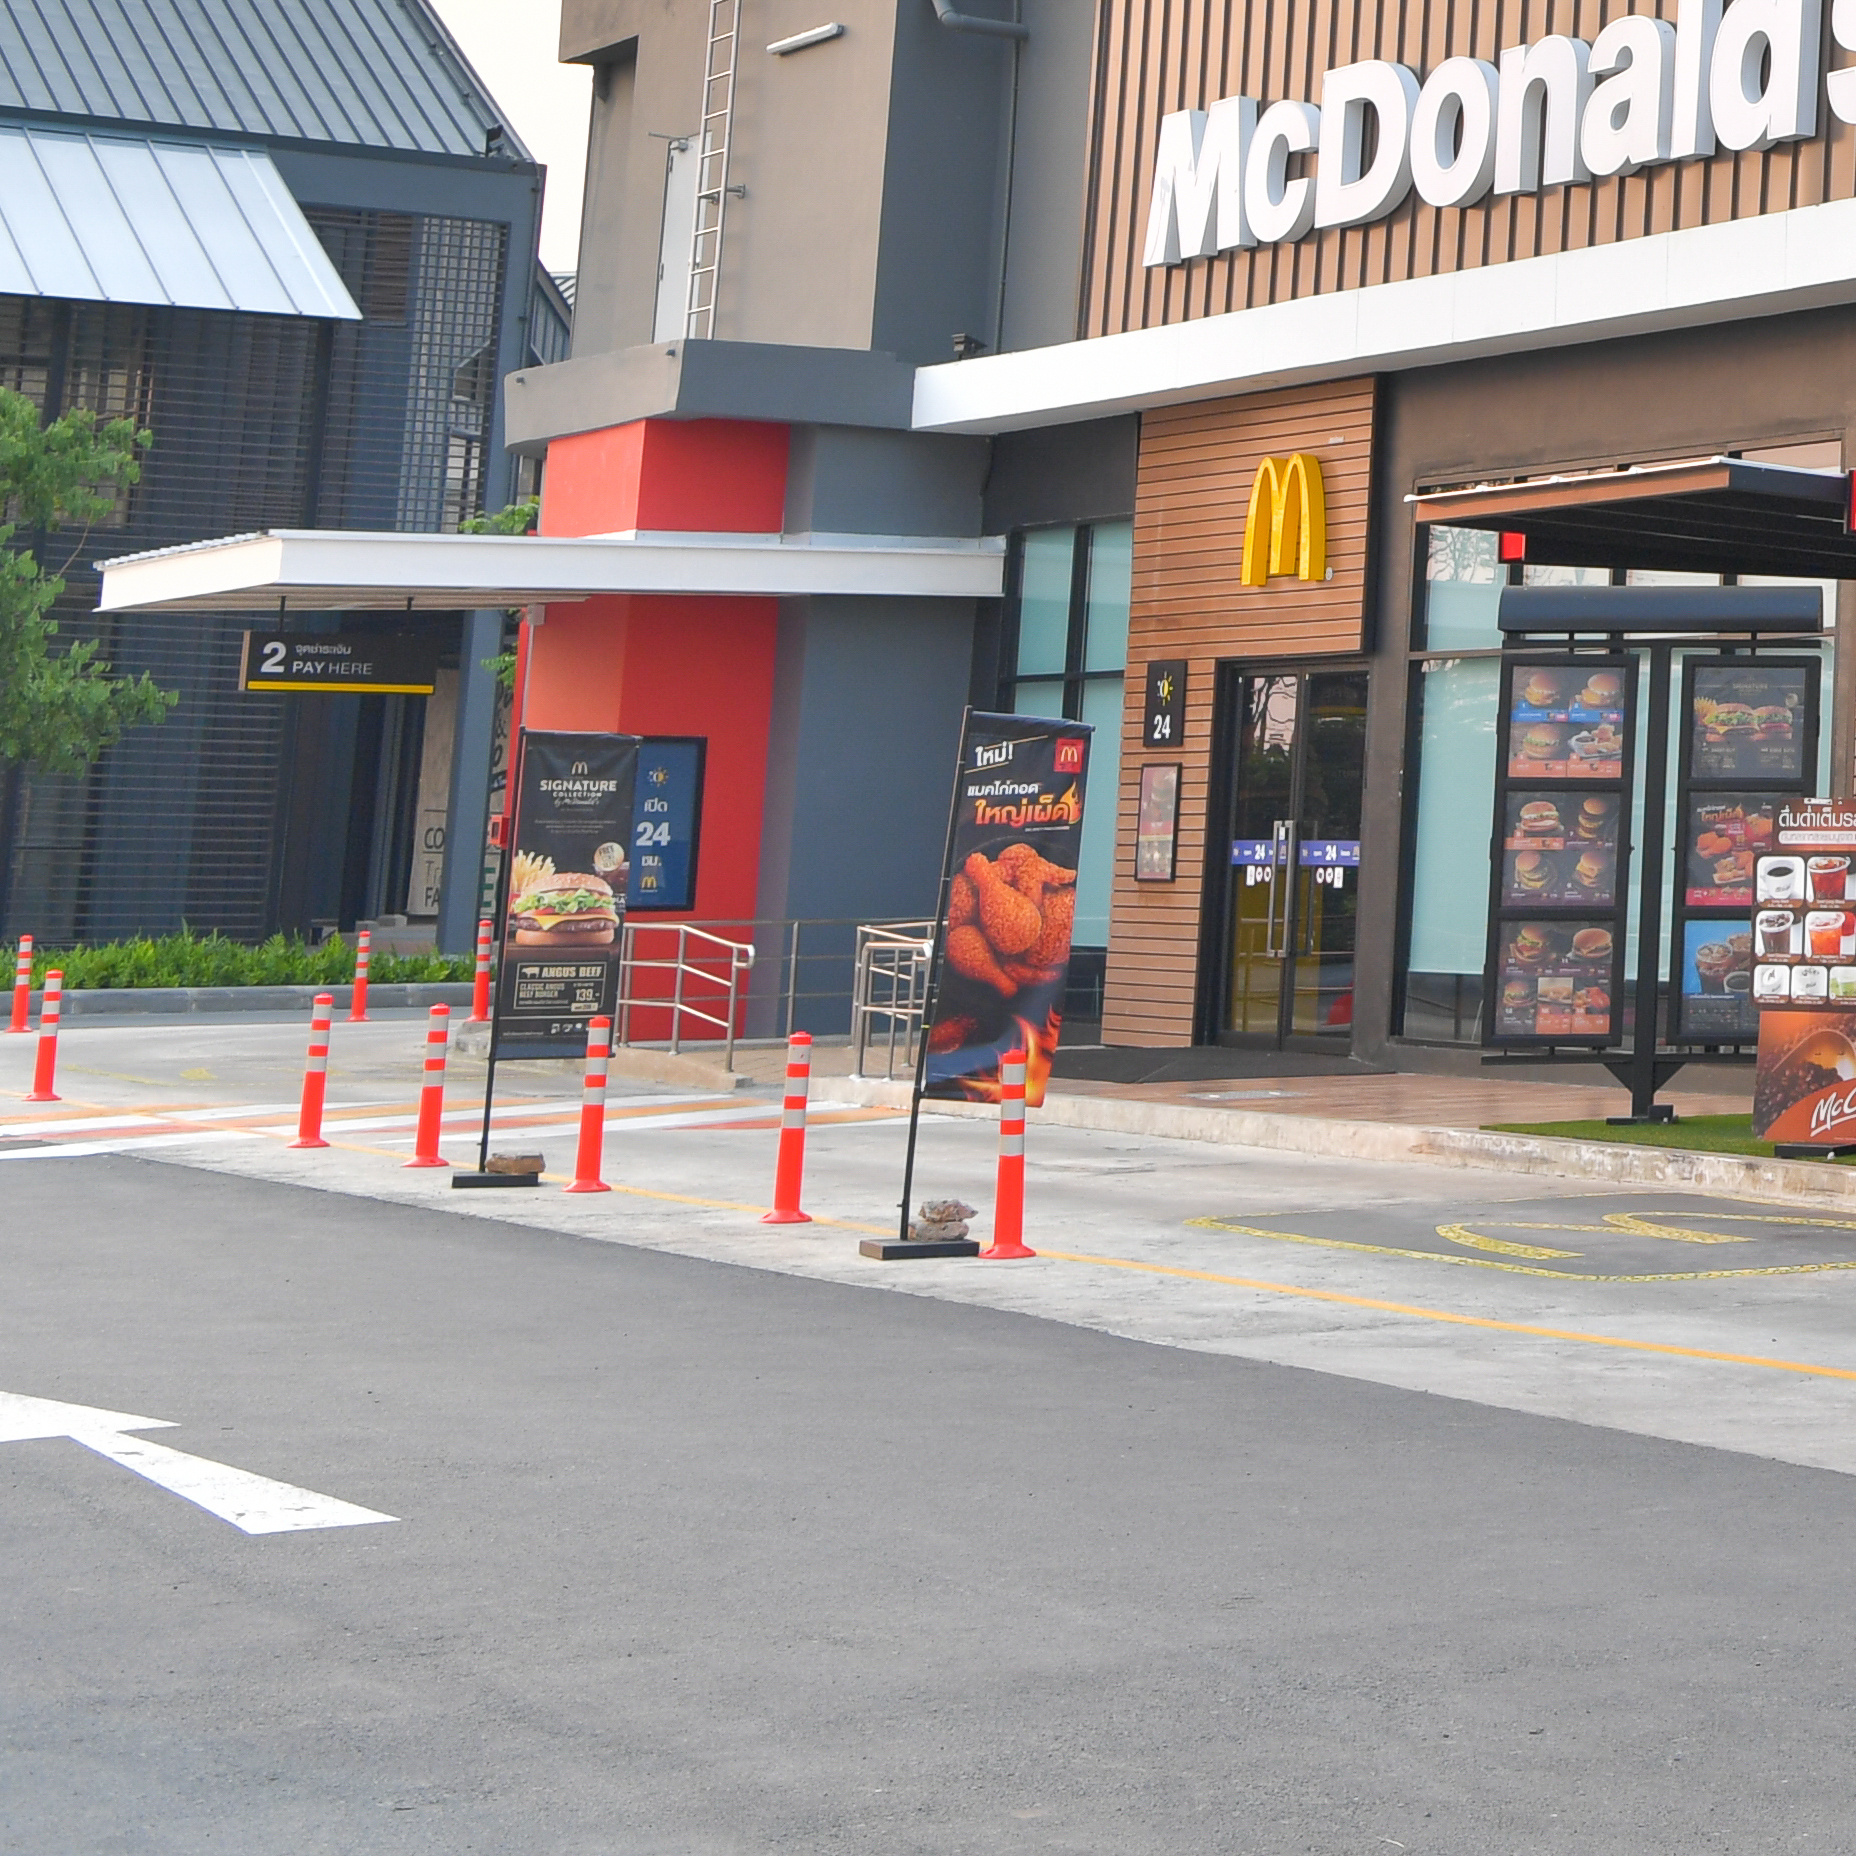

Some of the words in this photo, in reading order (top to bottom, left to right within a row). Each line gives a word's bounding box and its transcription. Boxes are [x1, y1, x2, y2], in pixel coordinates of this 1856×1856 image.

[260, 641, 287, 673] 2
[292, 660, 325, 674] PAY
[328, 661, 373, 675] HERE
[1153, 714, 1171, 739] 24
[975, 741, 1014, 767] ใหม่!
[539, 779, 618, 792] SIGNATURE
[967, 780, 1039, 797] แมคไก่ทอด
[644, 798, 668, 813] เปิด
[974, 794, 1070, 828] ใหญ่เผ็ด
[636, 821, 671, 846] 24
[1254, 844, 1266, 860] 24
[1325, 844, 1338, 861] 24
[641, 856, 662, 867] ชม.
[541, 966, 577, 978] ANGUS
[578, 965, 603, 978] BEEF
